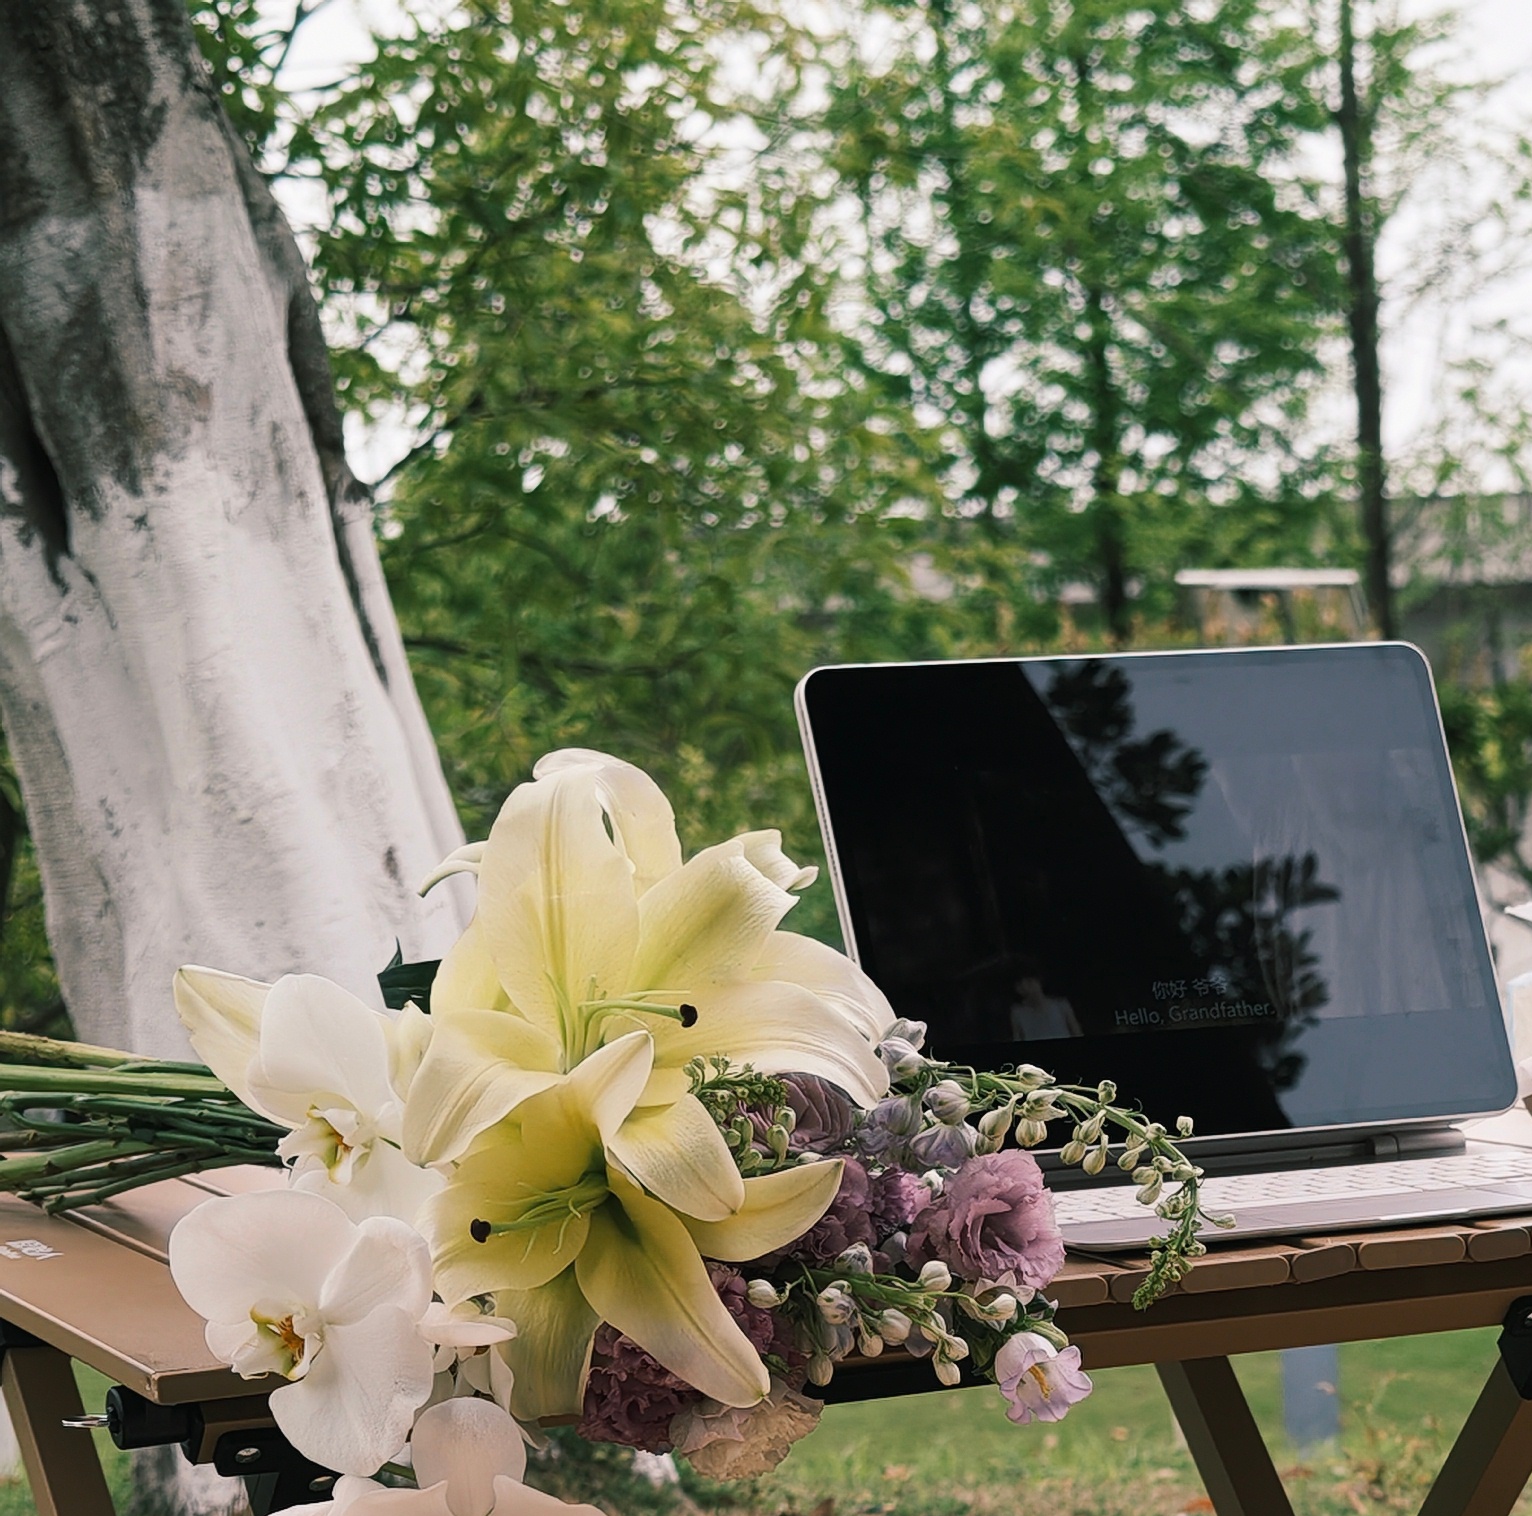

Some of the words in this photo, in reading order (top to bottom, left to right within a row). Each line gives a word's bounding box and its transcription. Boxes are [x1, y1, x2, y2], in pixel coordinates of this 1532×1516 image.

[1152, 980, 1187, 999] 你好
[1192, 976, 1228, 995] 爷爷
[1115, 1008, 1164, 1026] Hello,
[1168, 1001, 1276, 1021] Grandfather.
